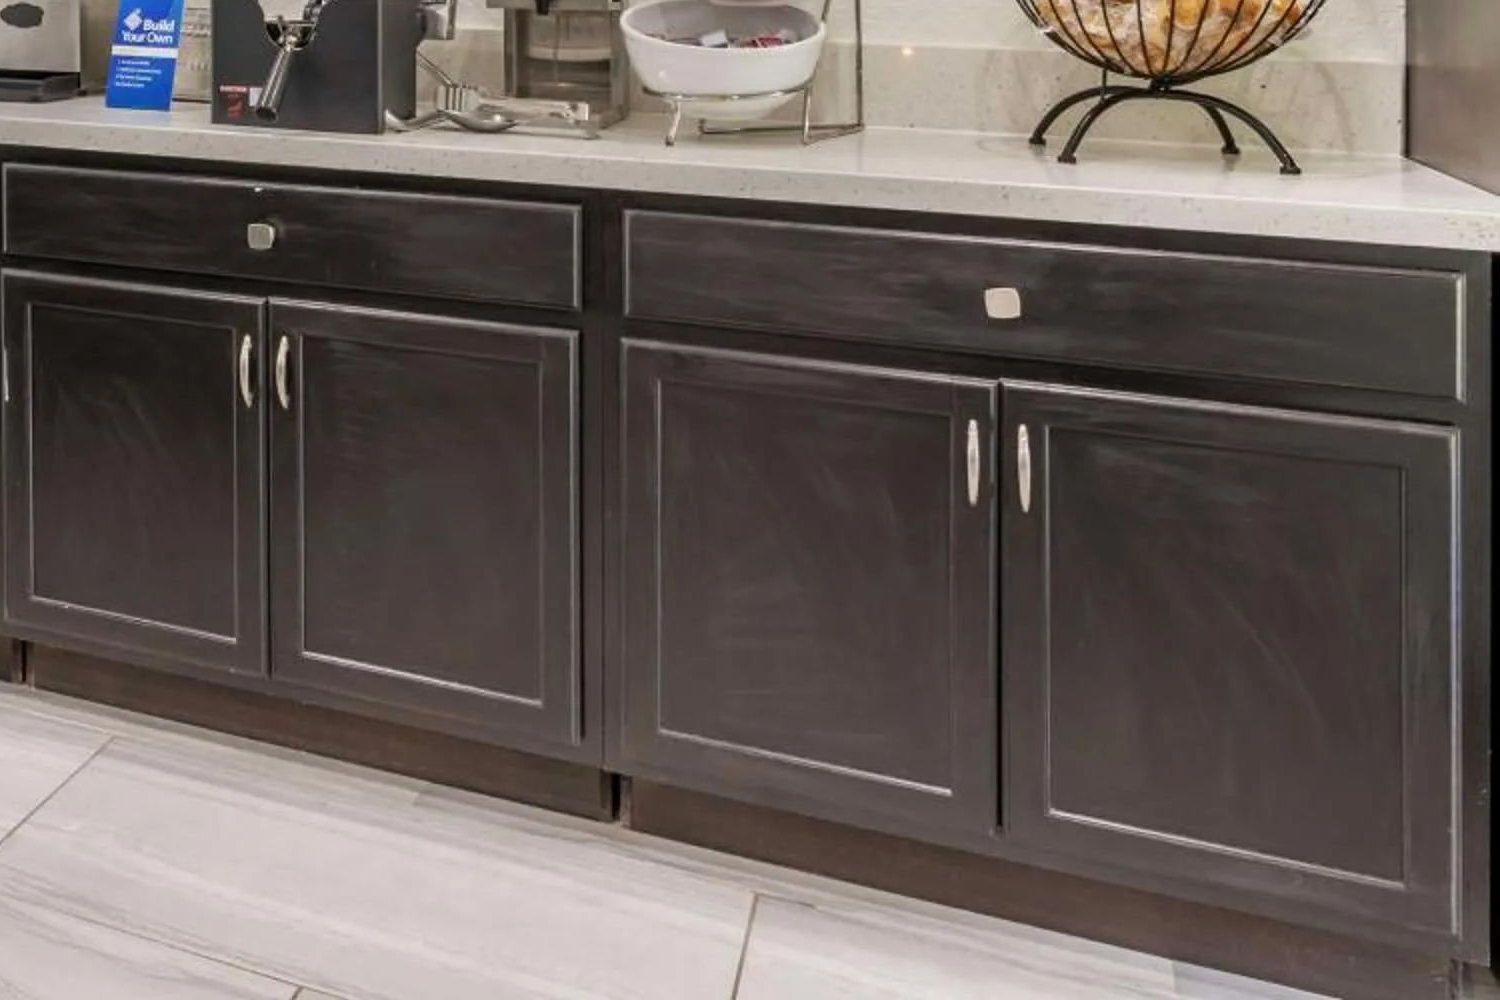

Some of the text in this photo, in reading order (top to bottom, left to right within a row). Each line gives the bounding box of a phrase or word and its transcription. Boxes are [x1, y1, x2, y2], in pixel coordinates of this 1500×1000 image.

[143, 18, 176, 32] Build
[121, 30, 174, 44] Your Own
